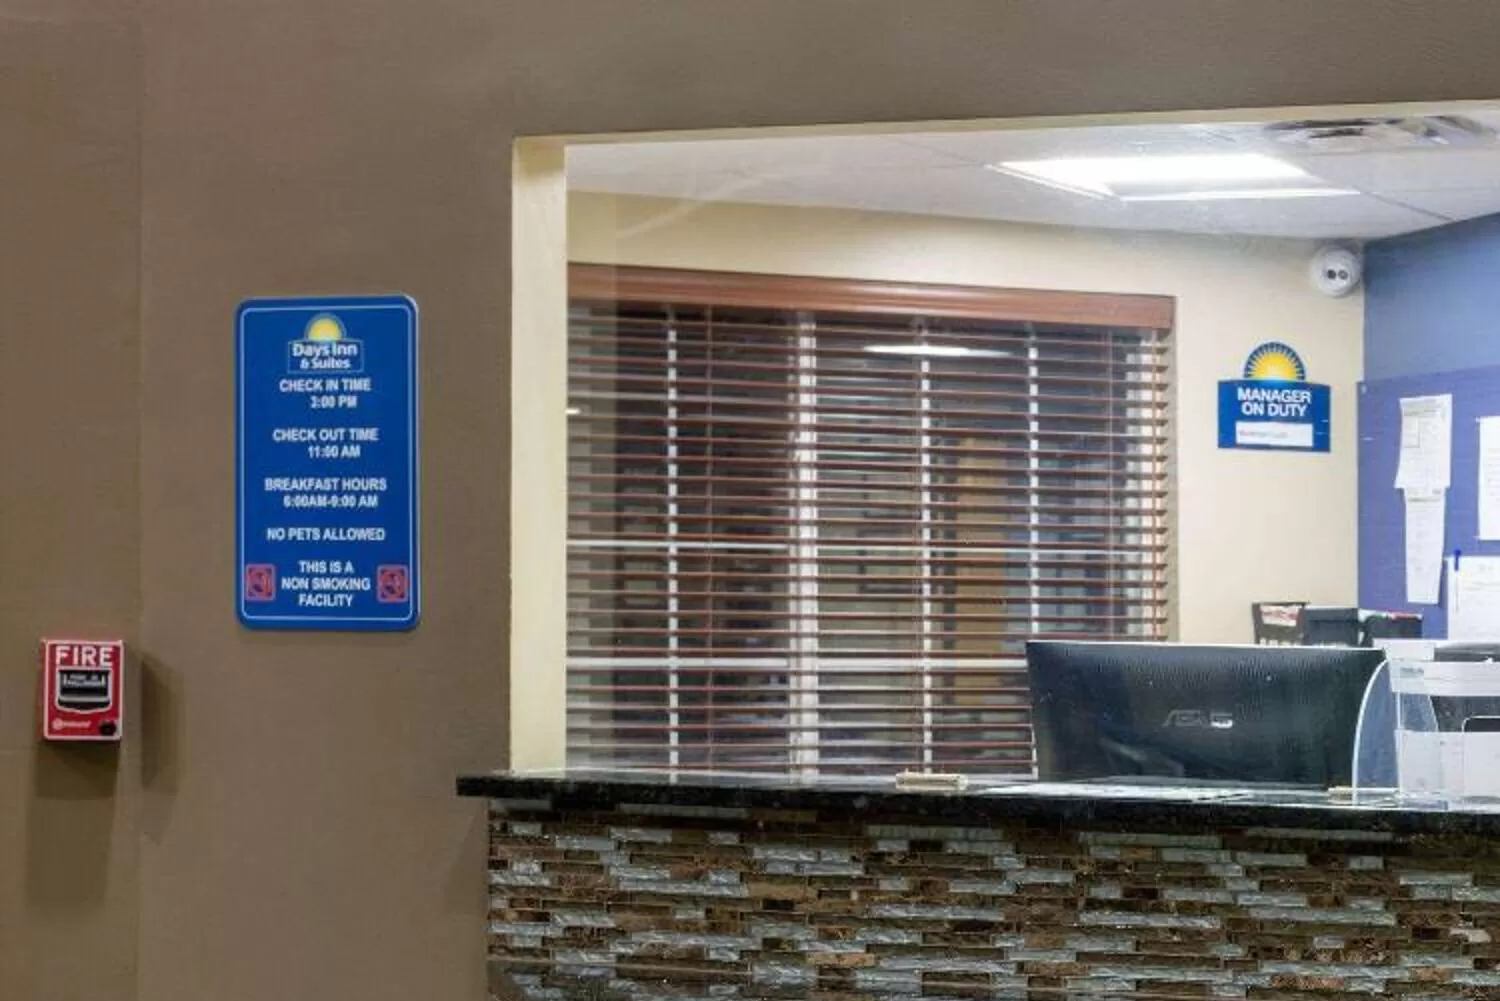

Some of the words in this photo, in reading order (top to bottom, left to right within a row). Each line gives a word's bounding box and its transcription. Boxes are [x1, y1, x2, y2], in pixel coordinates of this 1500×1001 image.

[292, 343, 330, 359] Days
[331, 343, 358, 356] Inn
[312, 358, 351, 369] Suites
[279, 377, 324, 392] CHECK
[325, 377, 339, 391] IN
[341, 377, 372, 391] TIME
[338, 395, 358, 408] PM
[1237, 387, 1313, 404] MANAGER
[1241, 401, 1265, 416] ON
[1267, 402, 1308, 417] DUTY
[272, 427, 317, 442] CHECK
[319, 428, 346, 441] OUT
[349, 427, 380, 441] TIME
[340, 445, 361, 459] AM
[264, 477, 340, 491] BREAKFAST
[342, 477, 387, 491] HOURS
[358, 495, 379, 507] AM
[267, 527, 285, 540] NO
[287, 527, 320, 541] PETS
[323, 527, 386, 541] ALLOWED
[299, 560, 327, 573] THIS
[329, 560, 342, 573] IS
[344, 560, 354, 573] A
[281, 577, 309, 590] NON
[311, 577, 371, 591] SMOKING
[298, 594, 353, 607] FACILITY
[55, 645, 113, 667] FIRE
